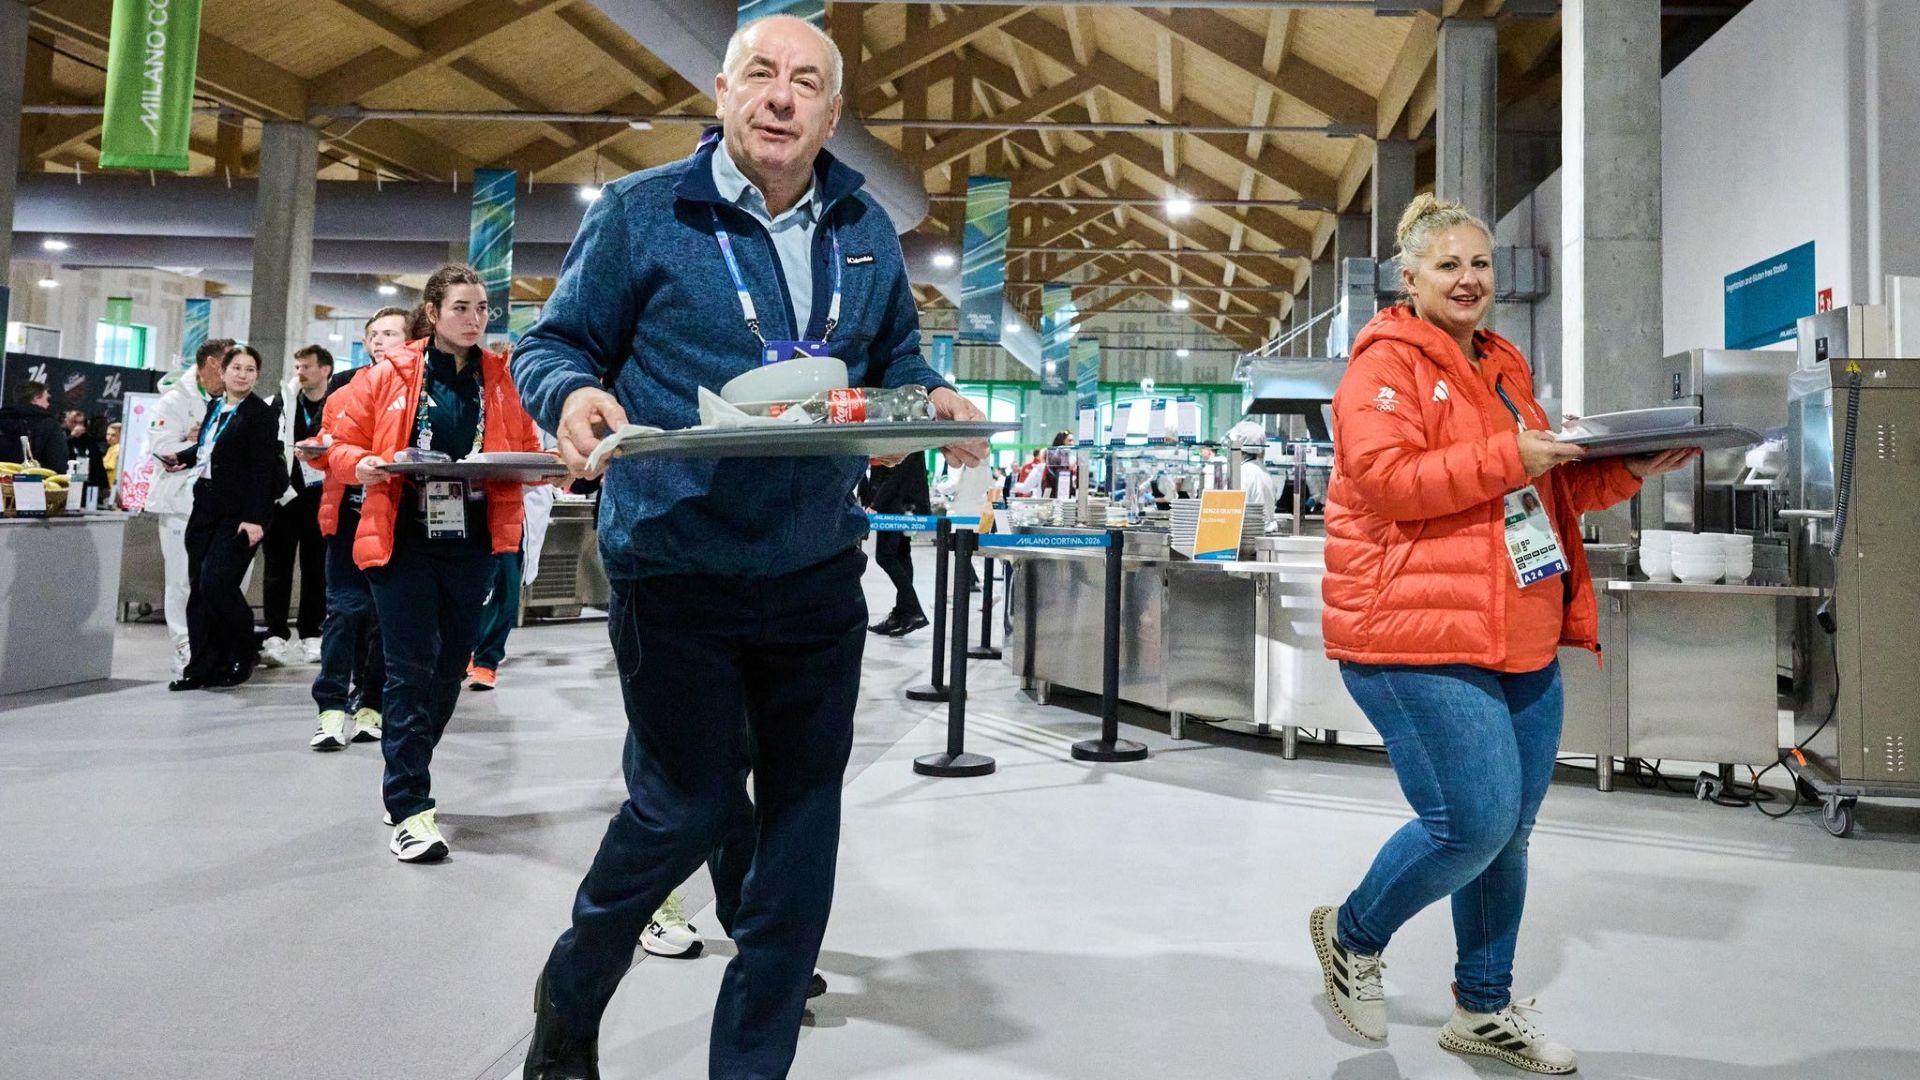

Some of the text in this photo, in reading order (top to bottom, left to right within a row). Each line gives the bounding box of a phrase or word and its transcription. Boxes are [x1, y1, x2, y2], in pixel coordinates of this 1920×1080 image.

[140, 30, 166, 137] MILANO
[1773, 263, 1788, 274] Station
[1016, 537, 1100, 545] MILANO CORTINA 2026
[1524, 562, 1563, 583] A24 R
